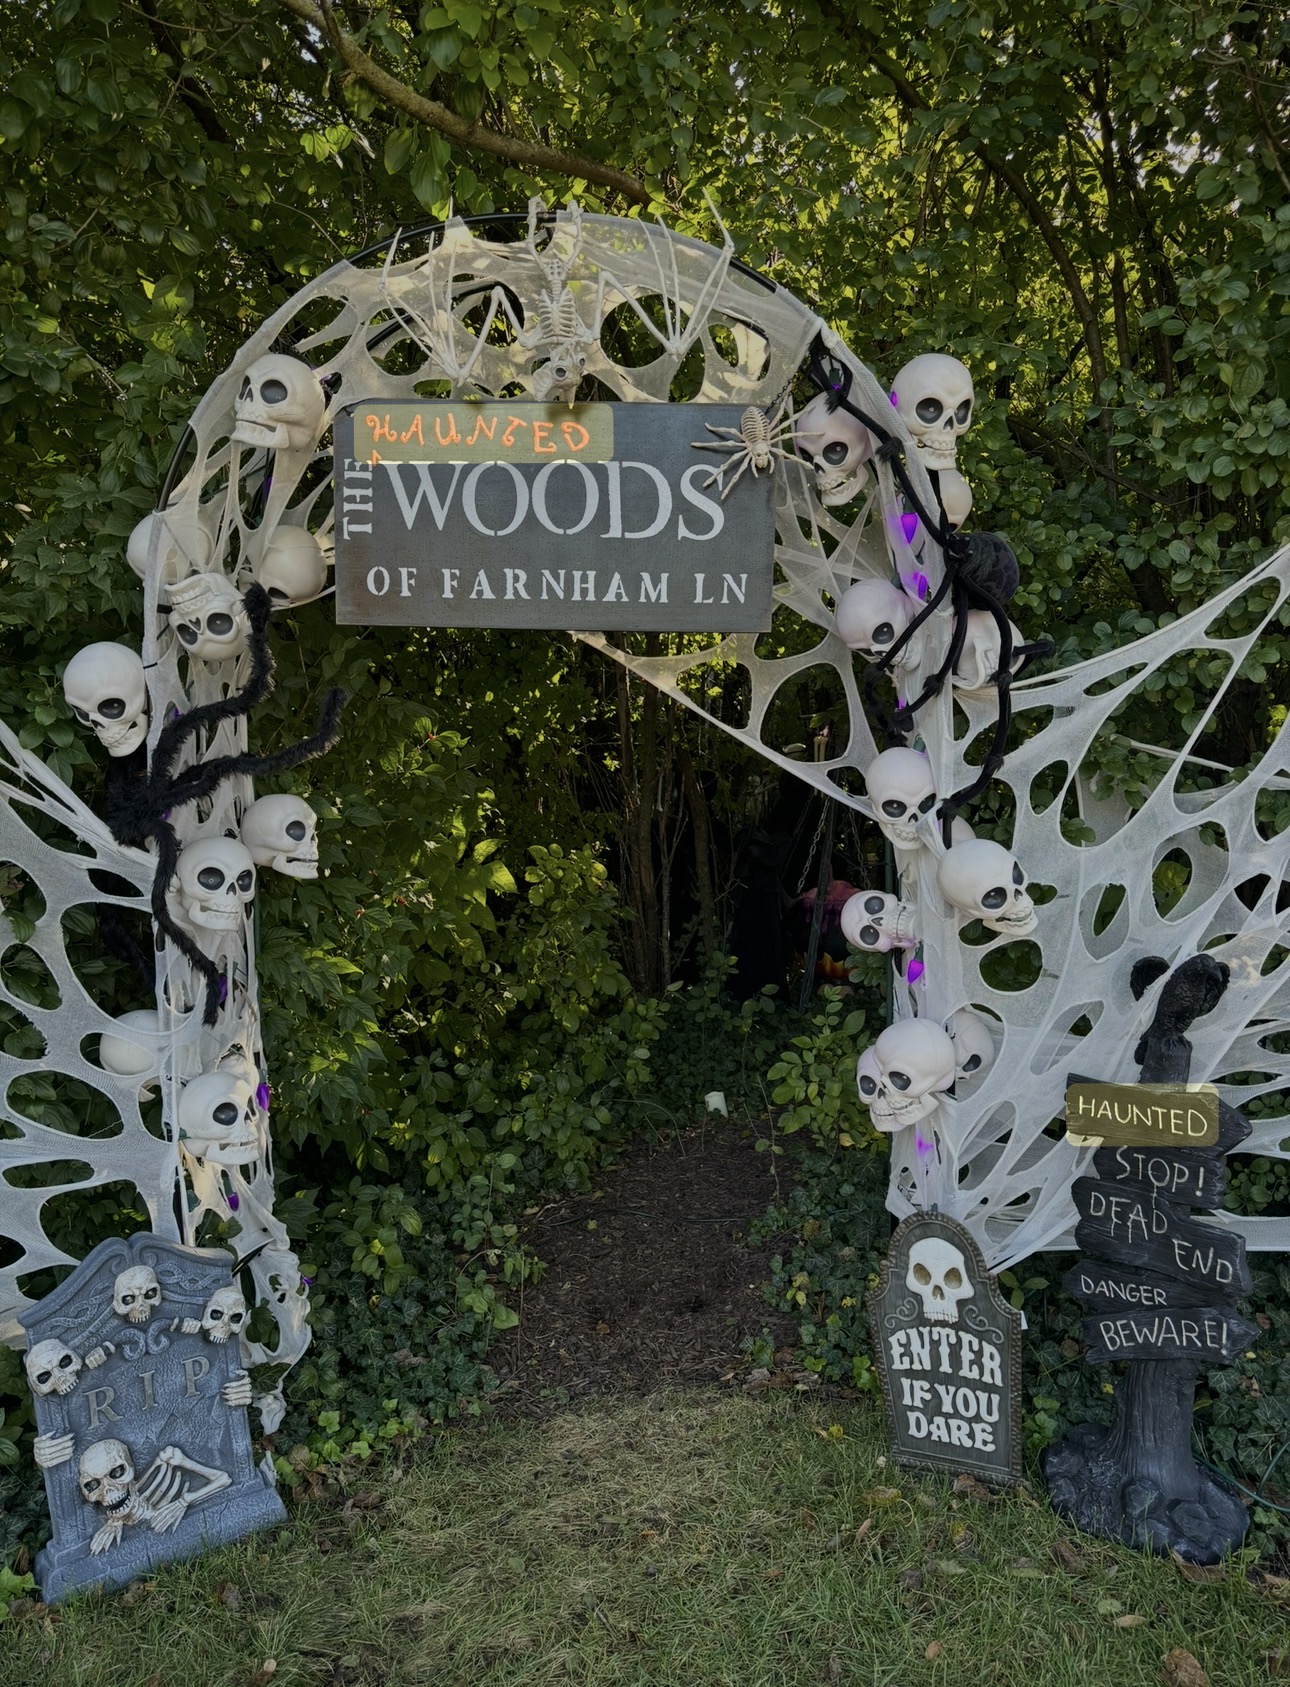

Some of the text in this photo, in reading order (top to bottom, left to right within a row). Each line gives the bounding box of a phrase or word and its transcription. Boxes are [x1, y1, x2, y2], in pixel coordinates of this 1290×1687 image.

[366, 413, 591, 454] HAUNTED
[343, 458, 373, 541] THE
[376, 459, 726, 541] WOODS
[366, 566, 748, 604] OF FARNHAM LN
[1078, 1095, 1208, 1137] HAUNTED
[1116, 1145, 1205, 1197] STOP!
[1090, 1192, 1168, 1243] DEAD
[1173, 1239, 1233, 1283] END
[1080, 1275, 1168, 1306] DANGER
[888, 1326, 1003, 1387] ENTER
[1100, 1317, 1228, 1355] BEWARE!
[900, 1377, 1000, 1423] IF YOU
[906, 1410, 996, 1453] DARE
